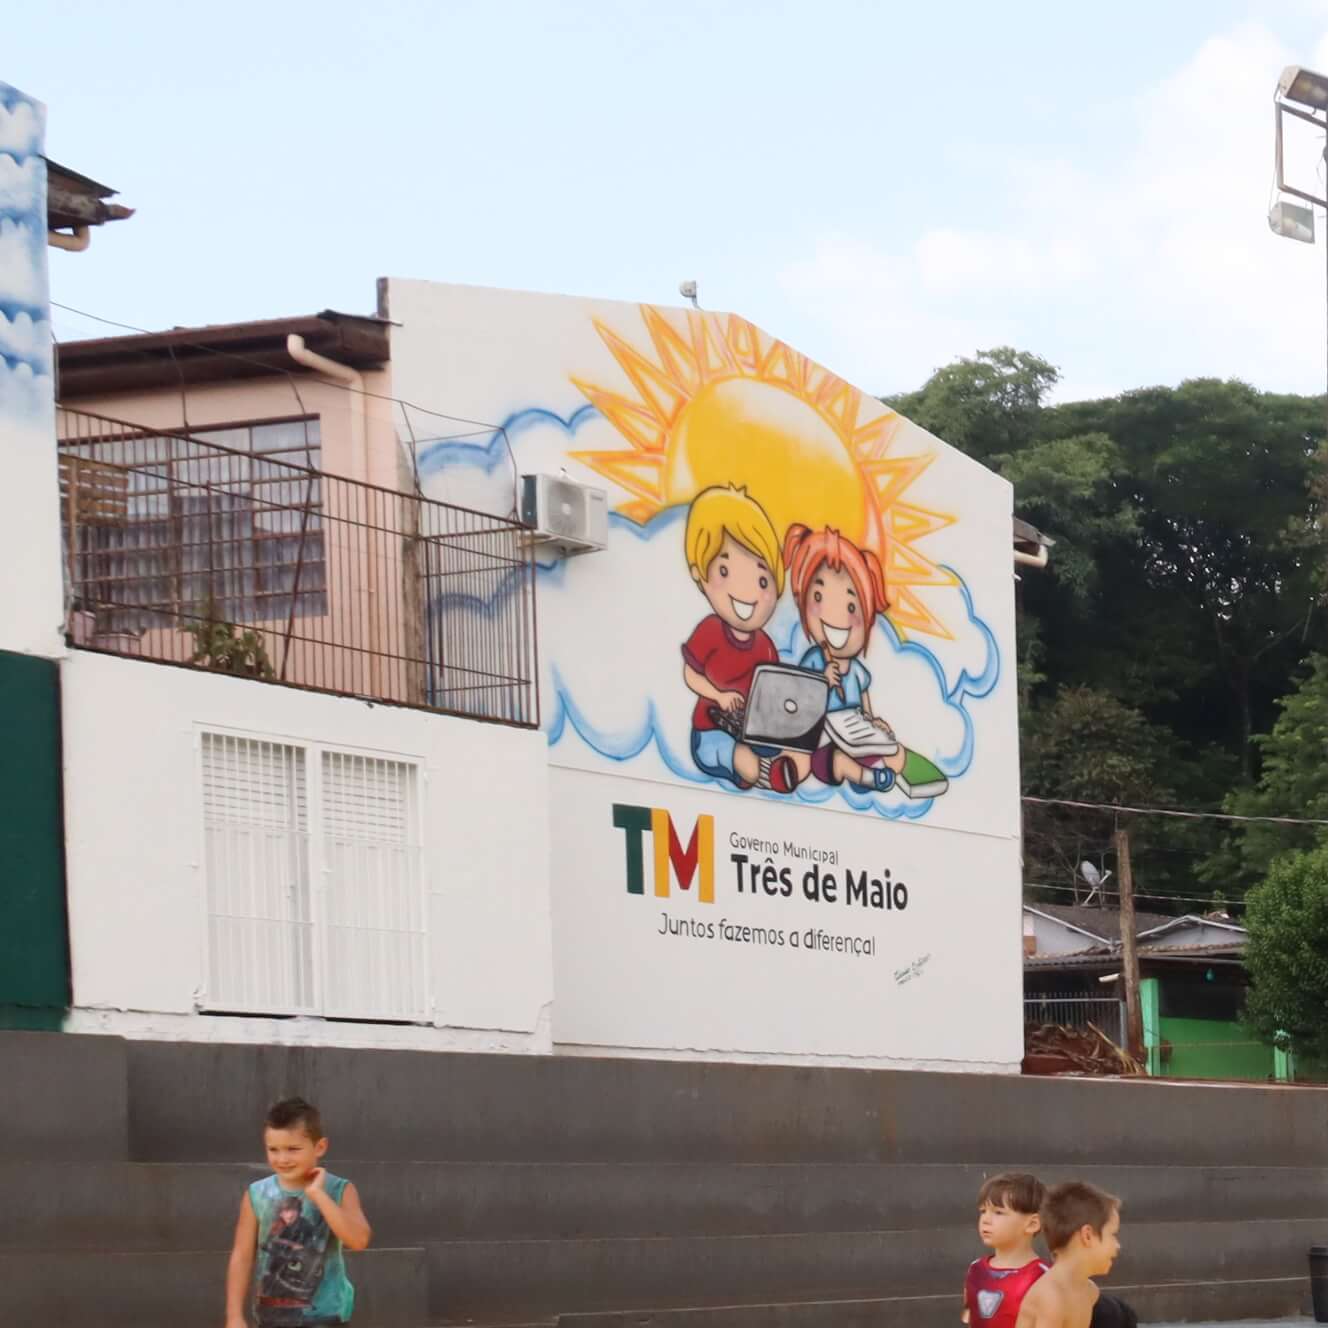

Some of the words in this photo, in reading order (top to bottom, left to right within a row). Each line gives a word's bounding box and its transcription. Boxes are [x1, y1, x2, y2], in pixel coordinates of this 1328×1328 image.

[612, 803, 715, 904] TM
[729, 831, 780, 854] Governo
[783, 841, 839, 866] Municipal
[730, 853, 793, 897] Três
[802, 863, 838, 903] de
[845, 868, 909, 911] Maio
[658, 912, 715, 939] Juntos
[718, 918, 785, 946] fazemos
[789, 931, 799, 948] a
